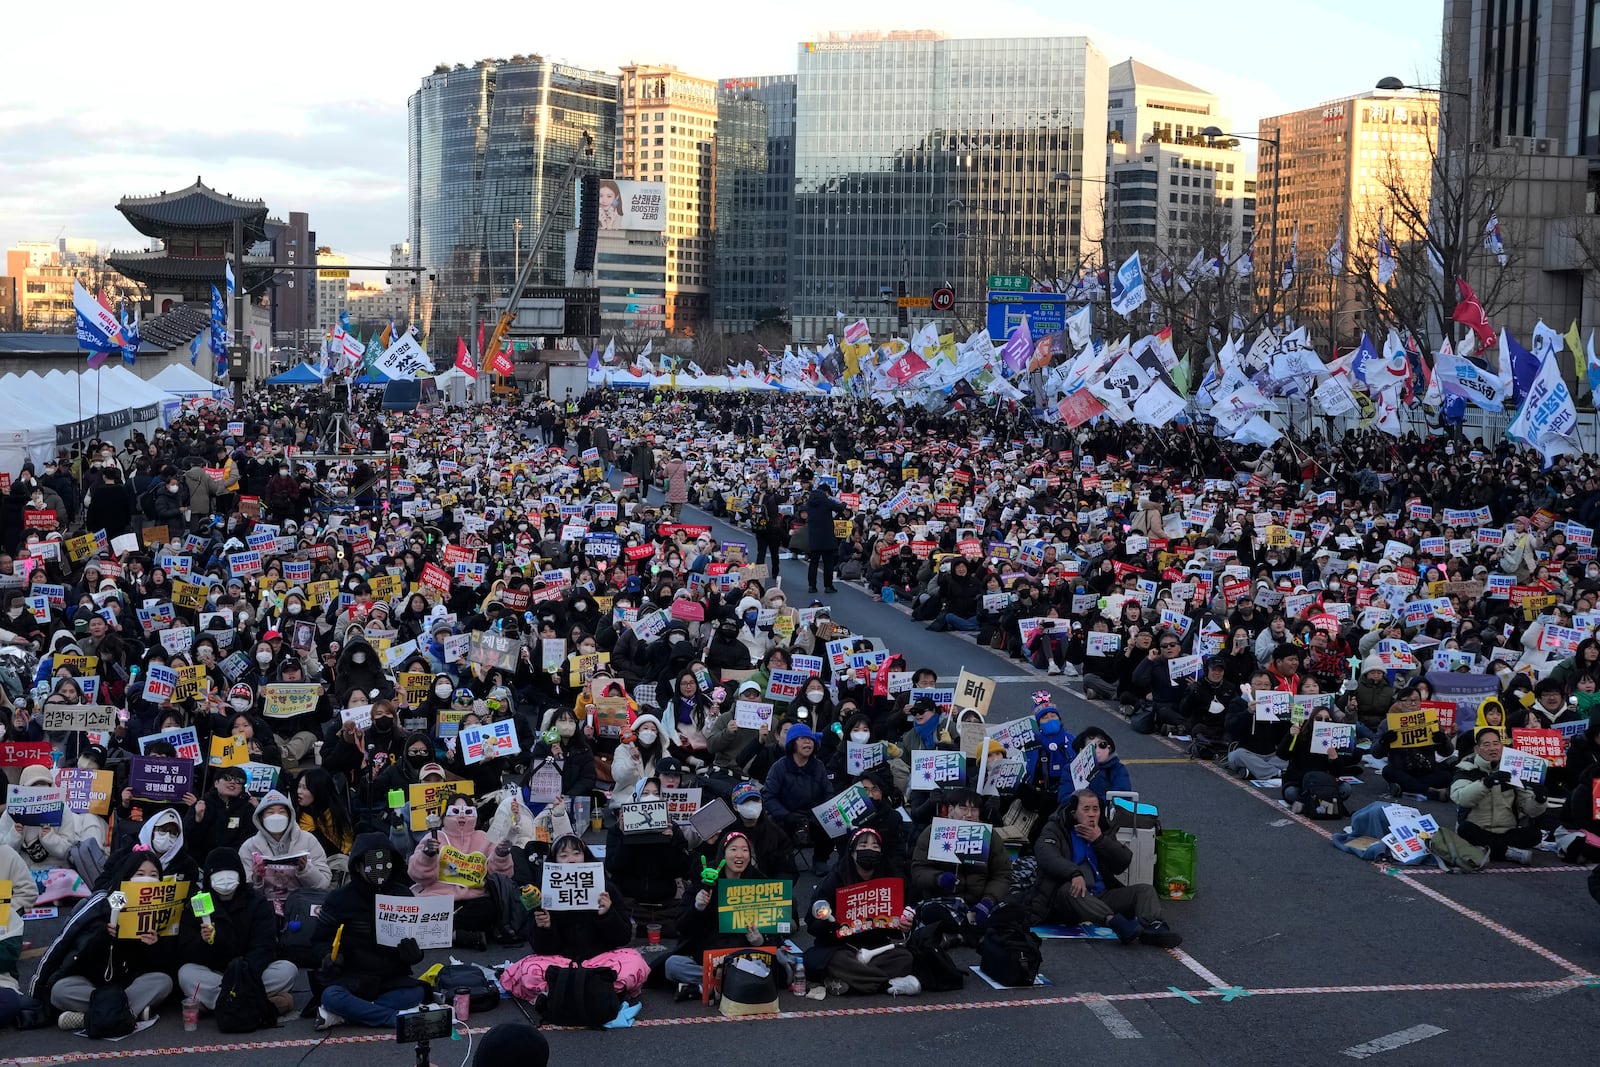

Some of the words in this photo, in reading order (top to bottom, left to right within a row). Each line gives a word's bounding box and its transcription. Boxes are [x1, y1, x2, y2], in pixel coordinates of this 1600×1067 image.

[631, 205, 660, 213] BOOSTER
[994, 278, 1022, 287] 광화문
[937, 294, 950, 305] 40
[482, 634, 509, 652] 제발
[176, 681, 198, 700] 파면
[46, 711, 75, 728] 검찰아
[79, 712, 110, 727] 기소해
[1400, 713, 1426, 725] 윤석열
[1012, 729, 1035, 748] 하라
[1330, 737, 1350, 749] 하라
[1401, 730, 1428, 746] 파면
[1516, 735, 1545, 746] 국민에게
[935, 753, 960, 768] 즉각
[1523, 757, 1543, 770] 즉각
[61, 770, 78, 779] 내가
[80, 770, 98, 779] 그게
[171, 764, 179, 773] 전
[251, 767, 274, 779] 즉각
[935, 767, 960, 782] 파면
[995, 774, 1016, 788] 하라
[1521, 770, 1542, 783] 파면
[145, 783, 175, 793] 경멸해요
[250, 778, 272, 792] 파면
[69, 791, 86, 799] 되는
[641, 802, 665, 811] PAIN
[934, 831, 956, 840] 윤석열
[957, 825, 984, 840] 즉각
[955, 839, 983, 855] 파면
[549, 871, 595, 889] 윤석열
[139, 884, 176, 905] 윤석열
[558, 888, 589, 906] 퇴진
[726, 881, 784, 904] 생명안전
[847, 887, 892, 907] 국민의힘
[396, 905, 420, 913] 쿠데타
[845, 901, 893, 920] 해체하라
[137, 907, 170, 936] 파면
[378, 911, 418, 923] 내란수괴
[420, 911, 450, 923] 윤석열
[732, 907, 777, 928] 사회로!
[416, 923, 449, 940] 구속!
